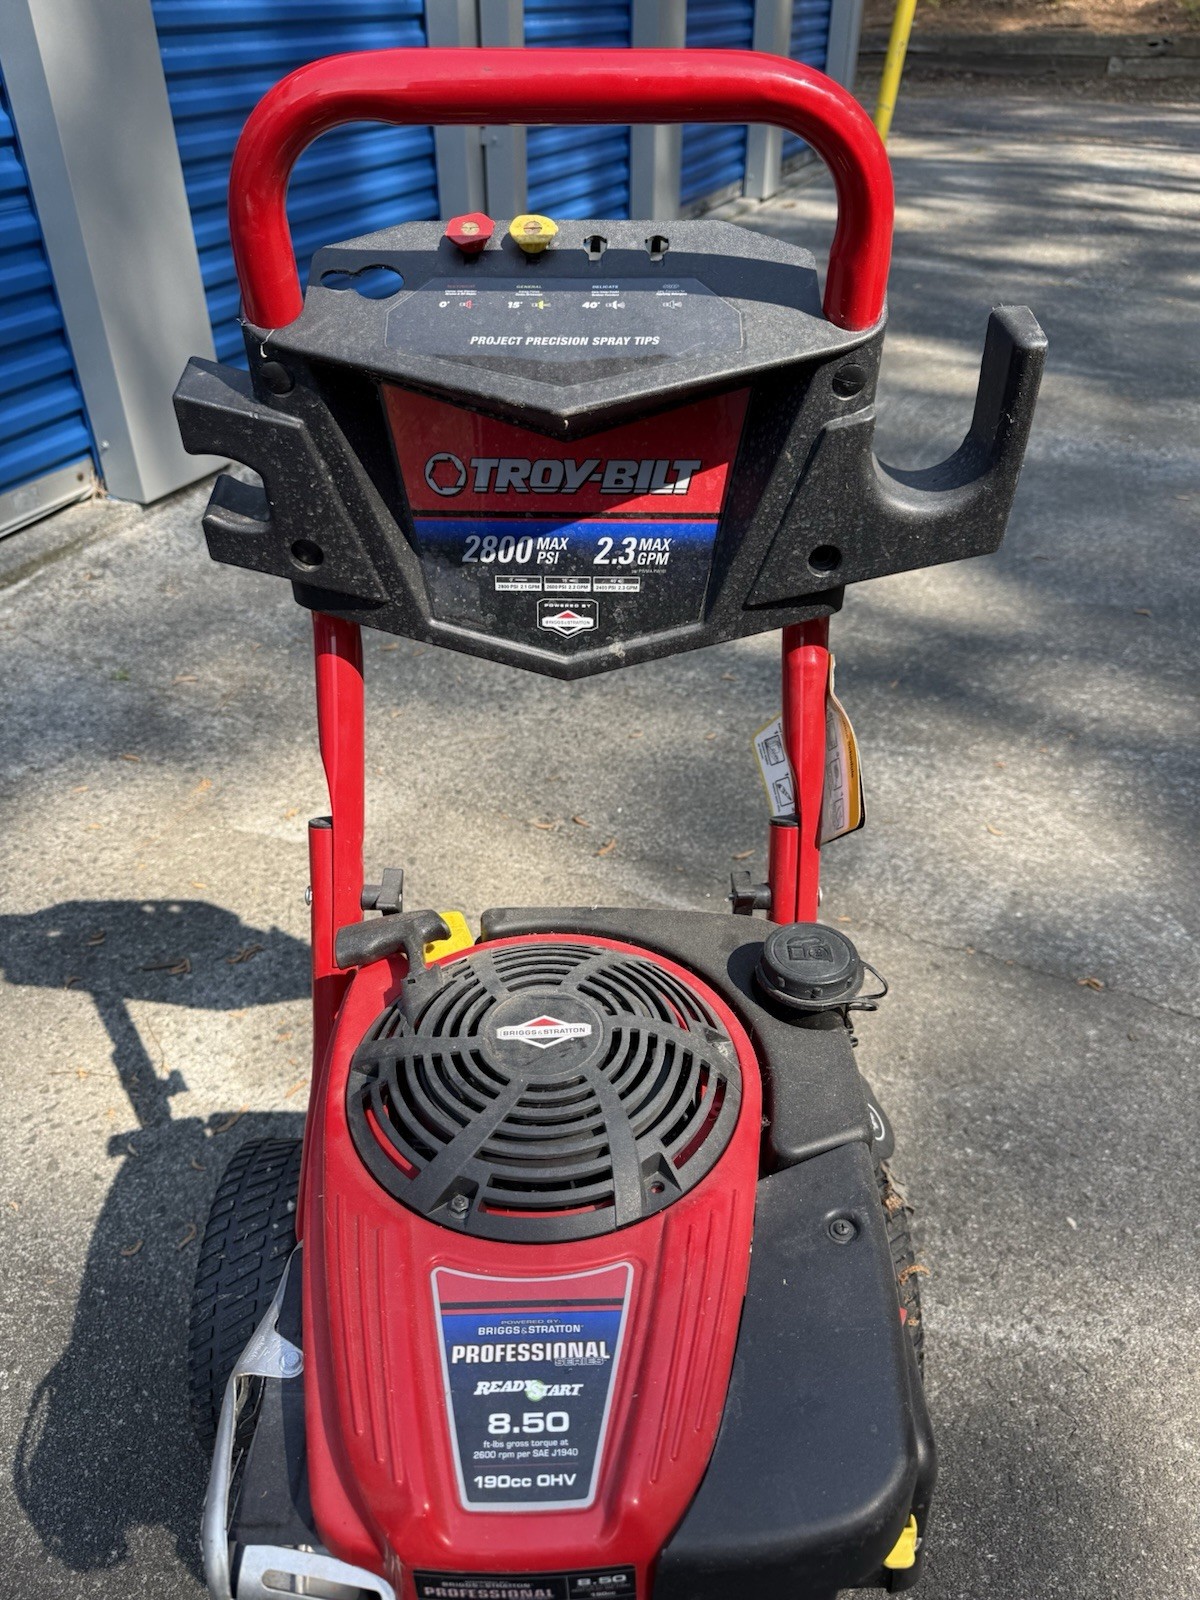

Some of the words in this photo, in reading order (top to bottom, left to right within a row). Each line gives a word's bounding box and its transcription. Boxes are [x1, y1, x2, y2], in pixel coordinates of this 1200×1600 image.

[469, 336, 523, 345] PROJECT
[525, 336, 589, 346] PRECISION
[592, 336, 631, 346] SPRAY
[634, 336, 660, 345] TIPS
[469, 457, 702, 496] TROY-BILT
[461, 534, 534, 564] 2800
[536, 537, 570, 551] MAX
[593, 536, 638, 565] 2.3
[639, 537, 673, 552] MAX
[536, 552, 560, 565] PSI
[637, 552, 670, 566] GPM
[451, 1341, 611, 1364] PROFESSIONAL
[554, 1356, 605, 1367] SERIES
[487, 1411, 570, 1435] 8.50
[483, 1440, 504, 1449] ft-lbs
[506, 1440, 530, 1450] gross
[530, 1439, 558, 1448] torque
[473, 1450, 496, 1460] 2600
[498, 1451, 515, 1460] rpm
[516, 1451, 531, 1460] per
[532, 1449, 550, 1458] SAE
[551, 1448, 579, 1457] J1940
[473, 1474, 532, 1489] 190cc
[536, 1473, 577, 1487] OHV
[423, 1586, 554, 1599] PROFESSIONAL
